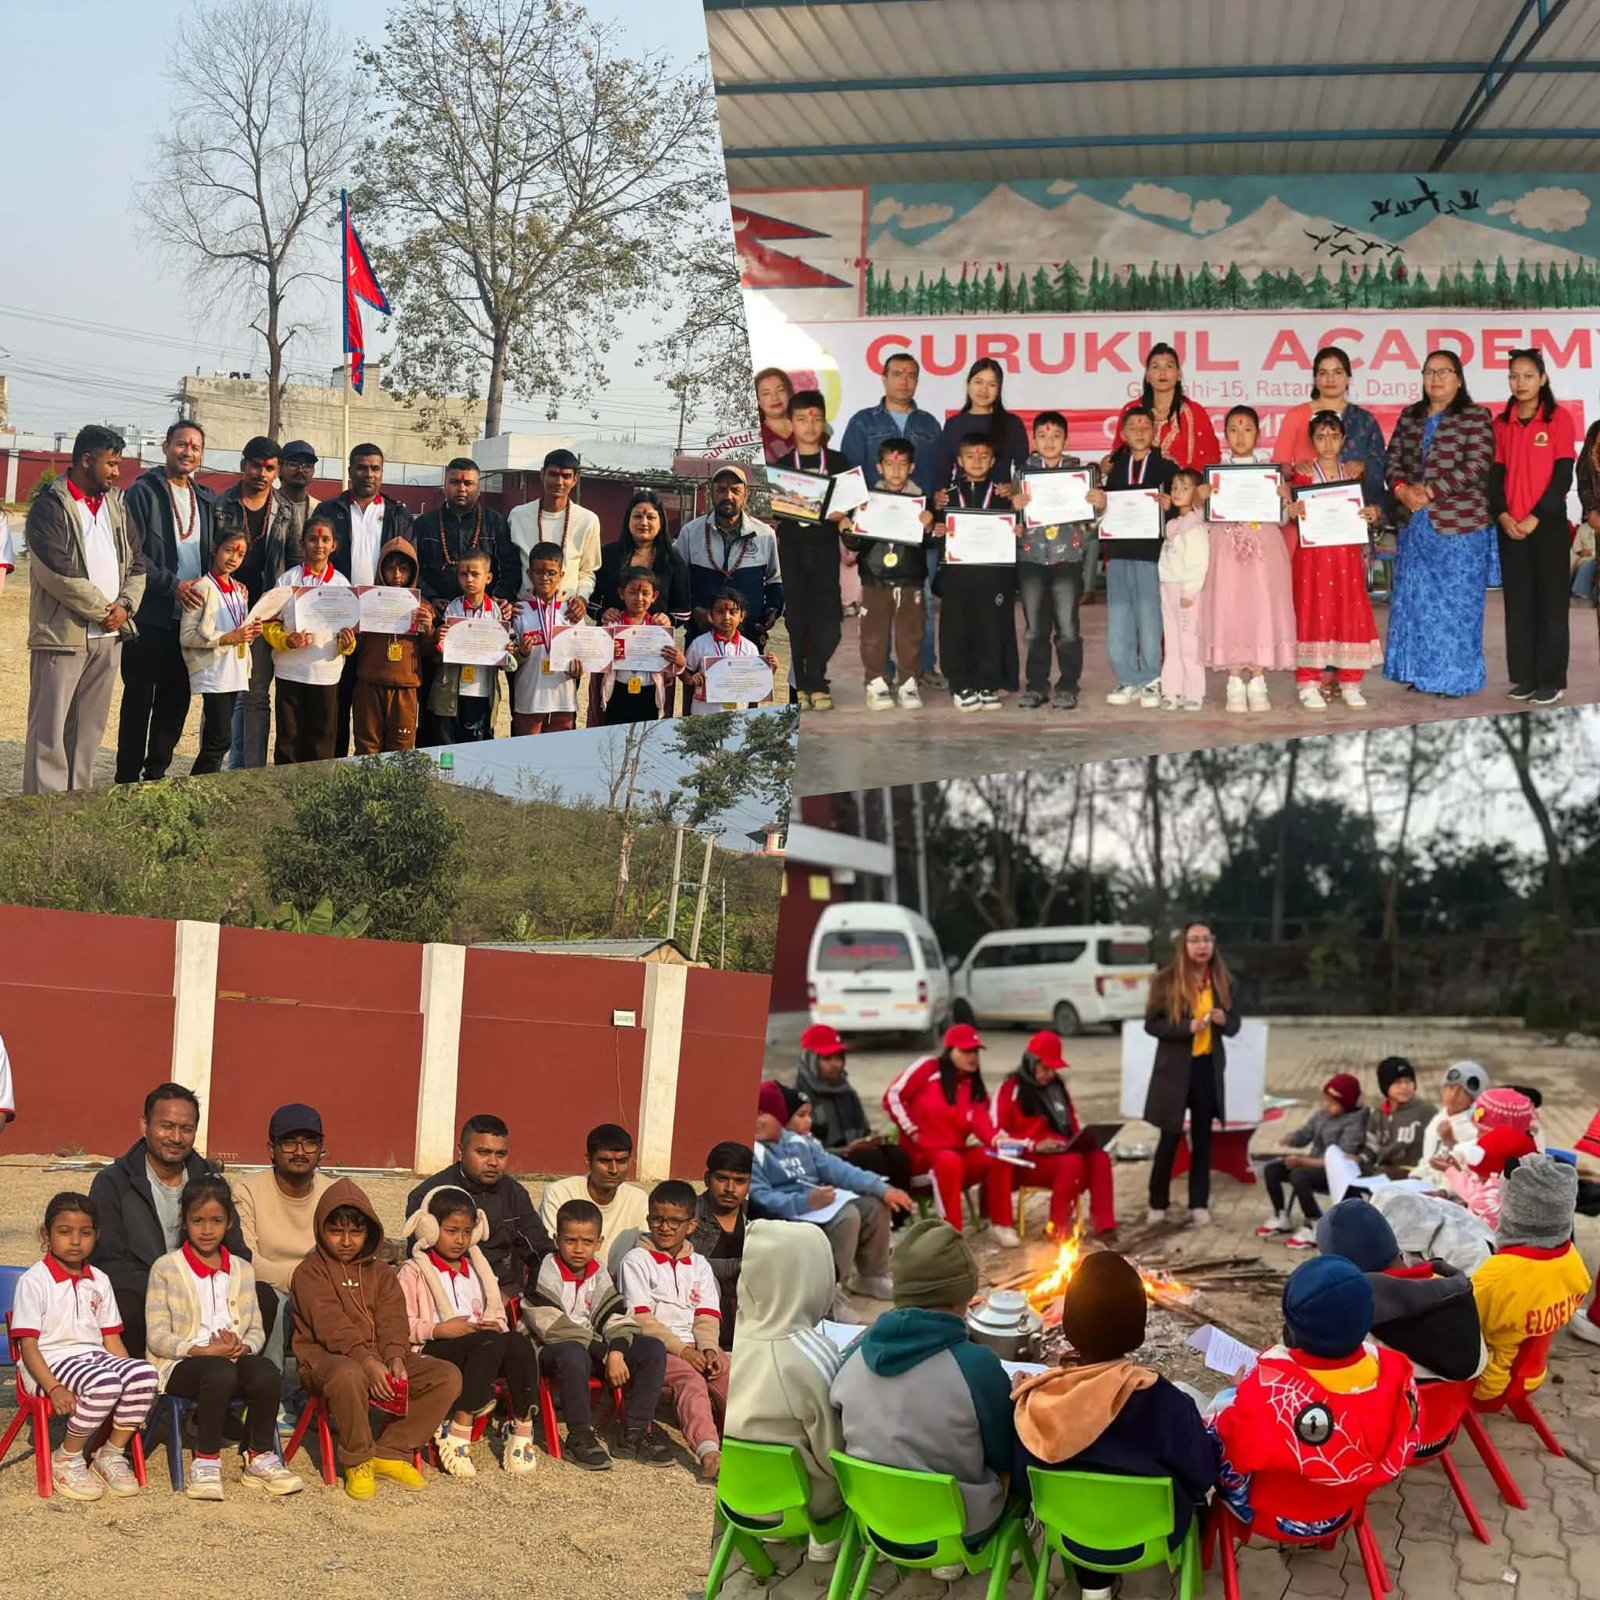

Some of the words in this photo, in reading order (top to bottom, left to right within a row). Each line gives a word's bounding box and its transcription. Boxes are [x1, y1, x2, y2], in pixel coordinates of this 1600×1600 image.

[865, 330, 1239, 377] GURUKUL
[1261, 327, 1600, 371] ACADEM
[1366, 379, 1420, 400] Dang
